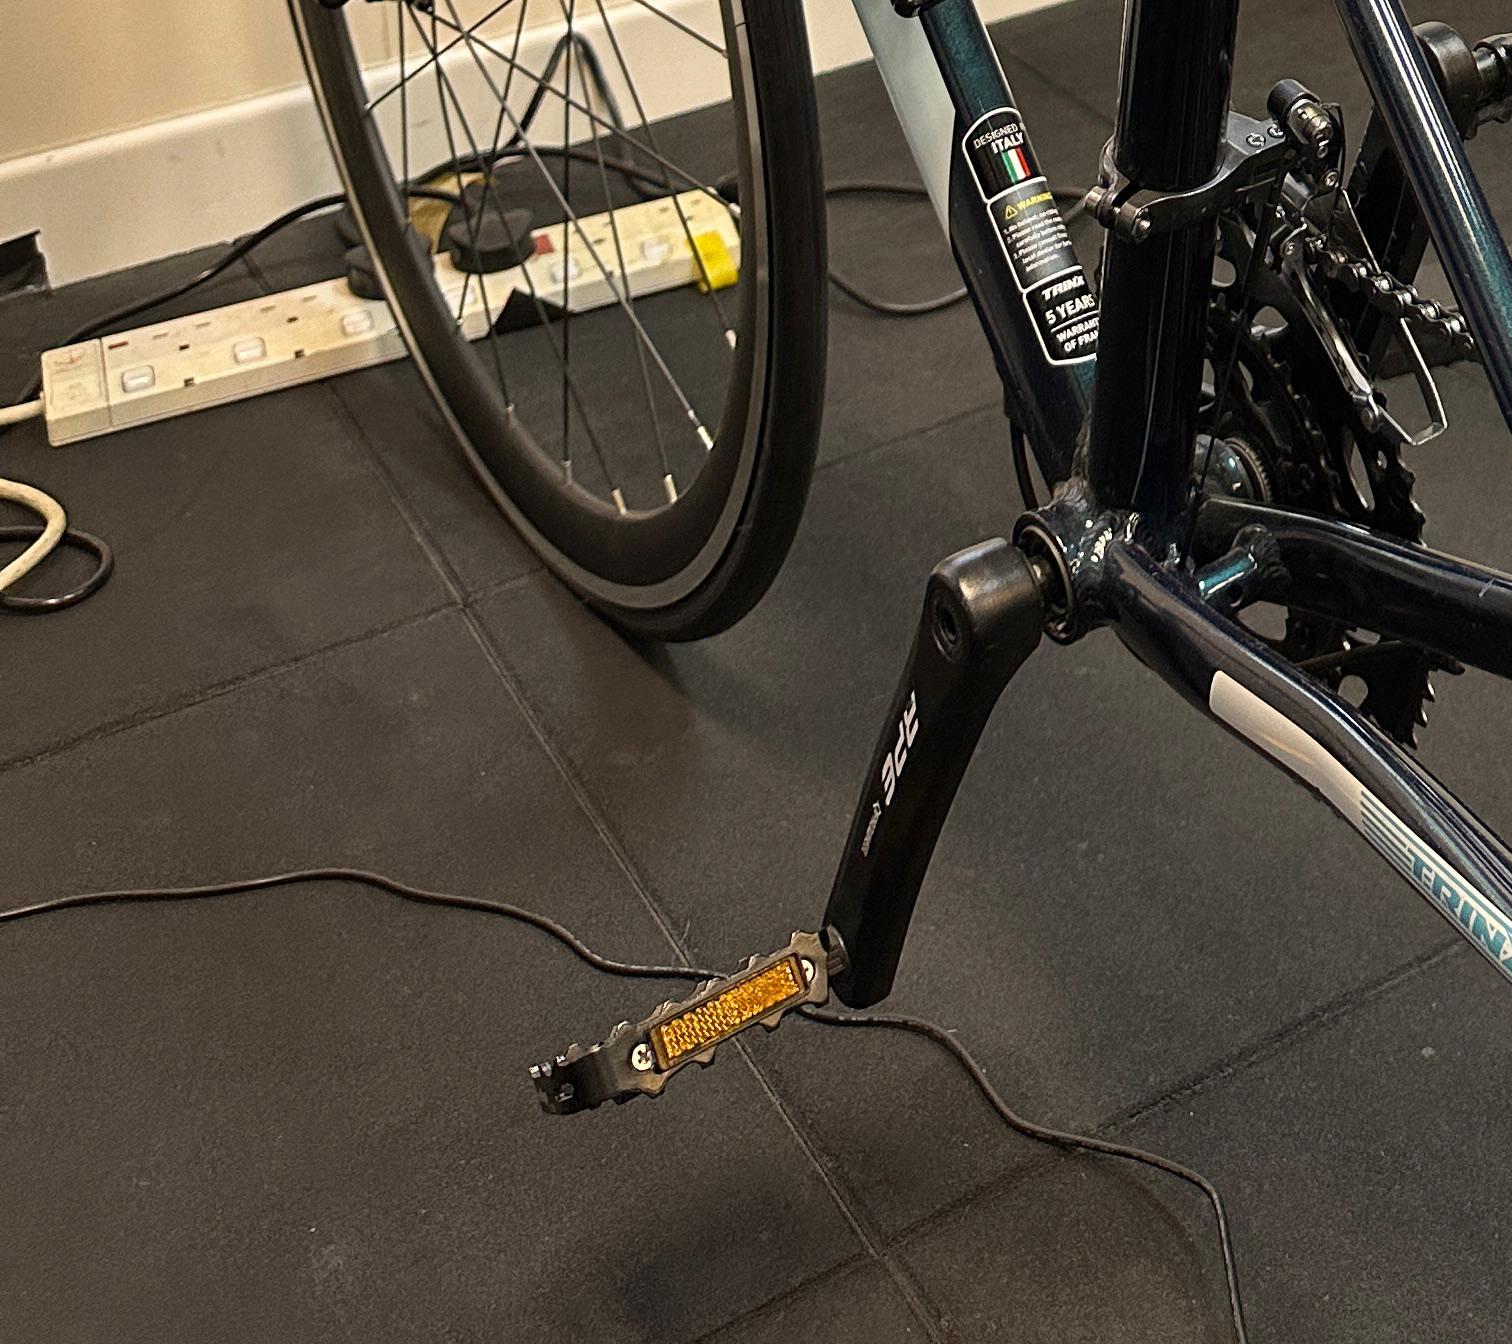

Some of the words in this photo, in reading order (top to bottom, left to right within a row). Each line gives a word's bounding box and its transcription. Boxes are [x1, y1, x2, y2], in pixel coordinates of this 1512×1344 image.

[973, 123, 1019, 150] DESIGNED
[990, 132, 1024, 154] ITALY
[1042, 275, 1085, 301] TRINX
[1045, 309, 1057, 324] 5
[1056, 293, 1096, 319] YEARS
[1056, 317, 1100, 343] WARRANT
[1064, 338, 1078, 352] OF
